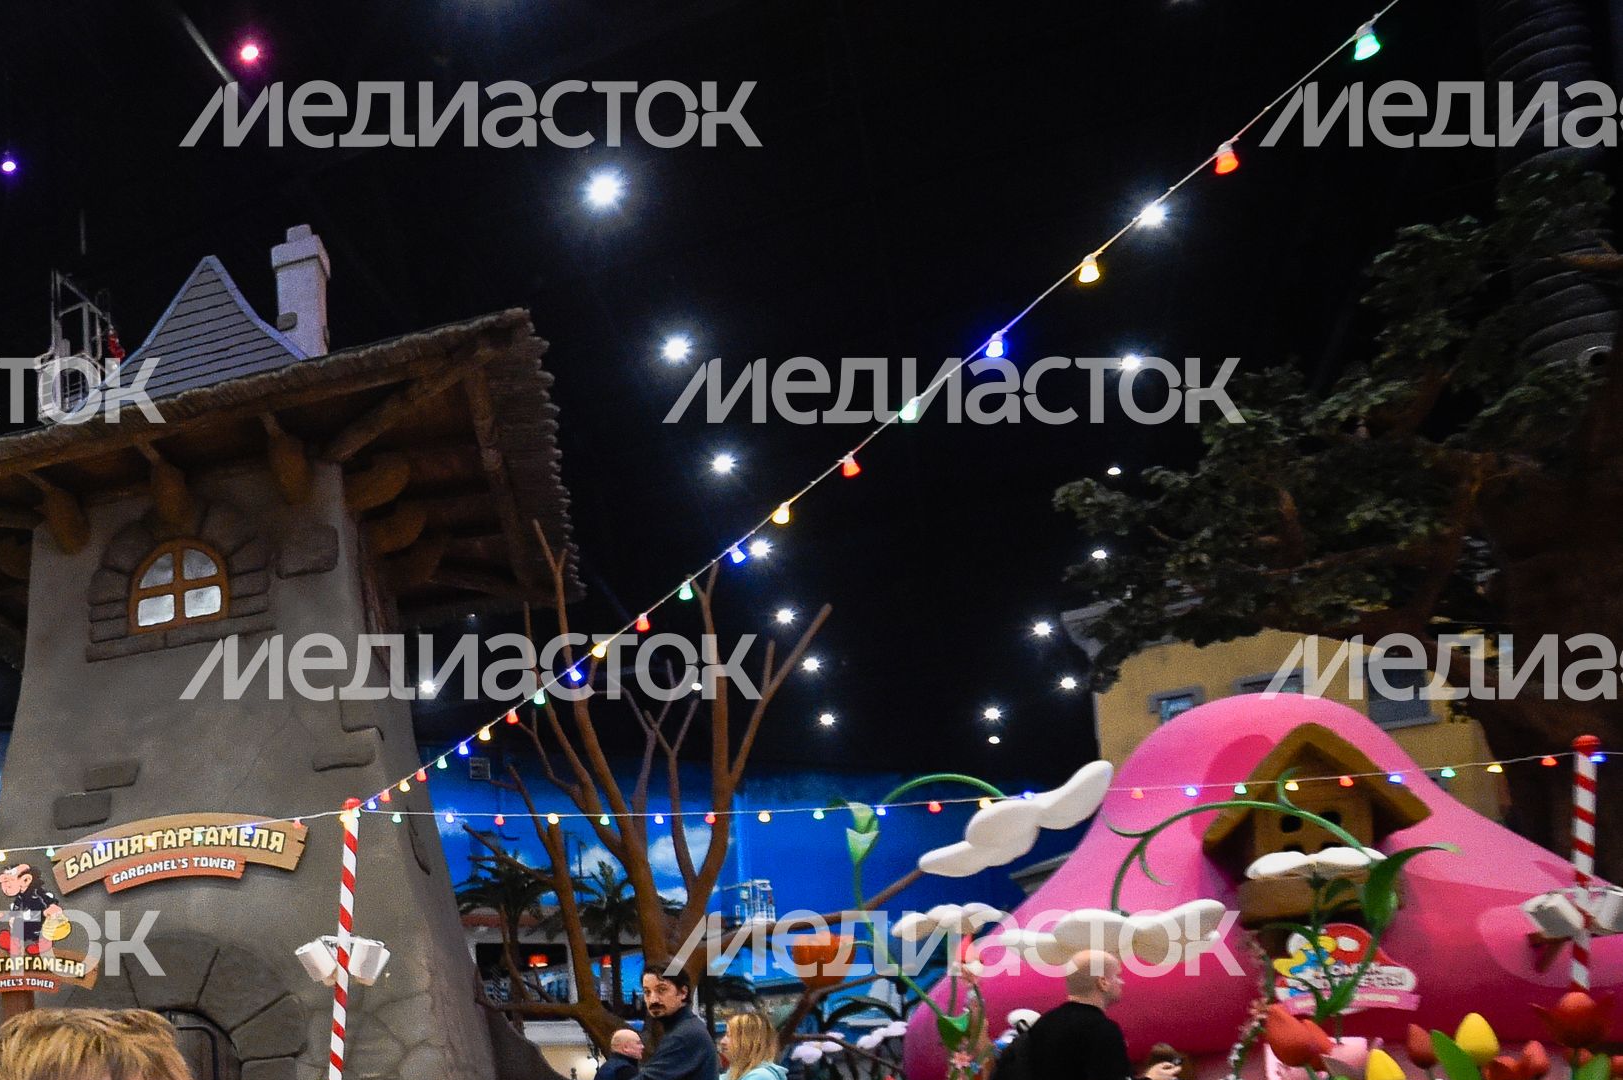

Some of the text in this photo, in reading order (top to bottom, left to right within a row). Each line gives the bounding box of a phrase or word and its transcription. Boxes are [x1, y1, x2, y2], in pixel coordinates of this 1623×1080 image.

[64, 826, 286, 880] БАШНЯ ГАРГАМЕЛЯ
[111, 856, 236, 885] GARGAMEL'S TOWER
[26, 978, 55, 990] TOWER
